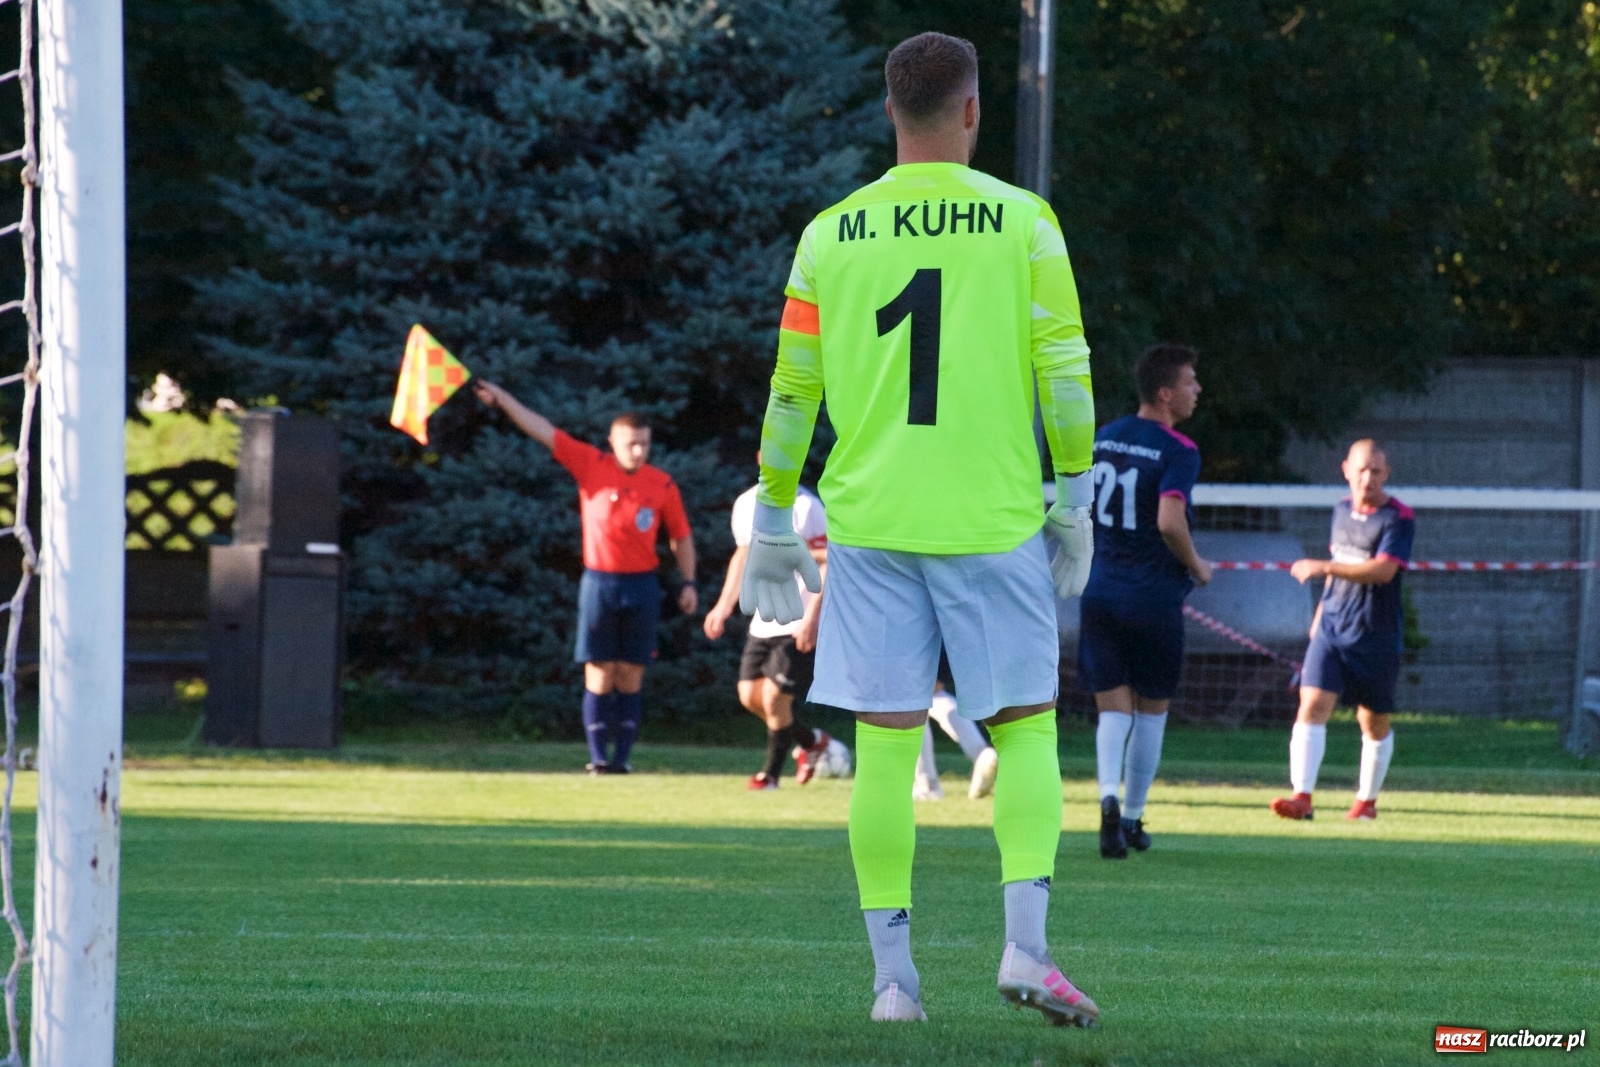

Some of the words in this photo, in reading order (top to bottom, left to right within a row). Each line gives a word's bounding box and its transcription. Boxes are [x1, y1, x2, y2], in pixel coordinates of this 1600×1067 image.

[838, 209, 876, 242] M.
[894, 198, 1004, 237] KÜHN
[875, 268, 942, 426] 1
[1094, 461, 1139, 530] 21
